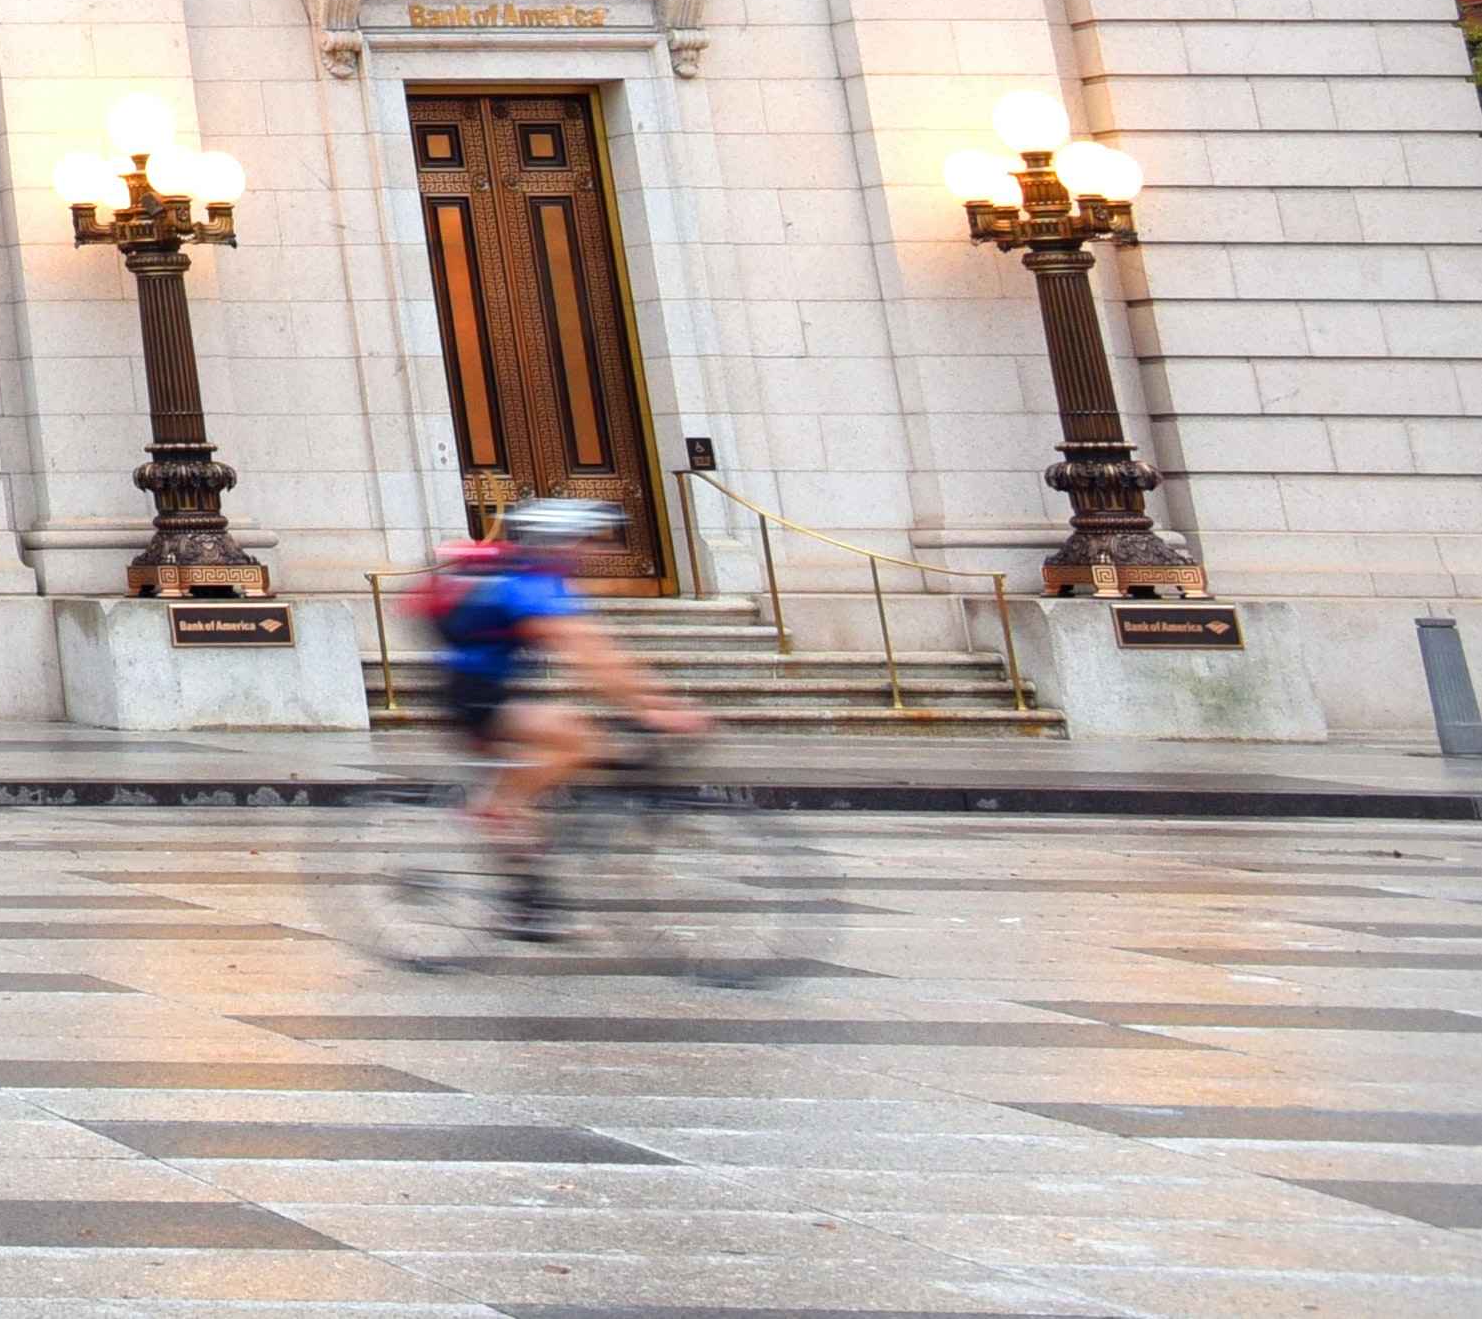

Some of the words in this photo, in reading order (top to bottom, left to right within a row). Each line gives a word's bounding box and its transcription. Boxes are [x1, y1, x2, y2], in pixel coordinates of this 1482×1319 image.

[408, 2, 470, 28] Bank
[474, 2, 498, 28] of
[503, 2, 607, 28] America
[179, 620, 205, 631] Bank
[205, 620, 214, 631] of
[215, 620, 256, 631] America
[1123, 621, 1149, 632] Bank
[1149, 621, 1160, 631] of
[1161, 621, 1202, 632] America
